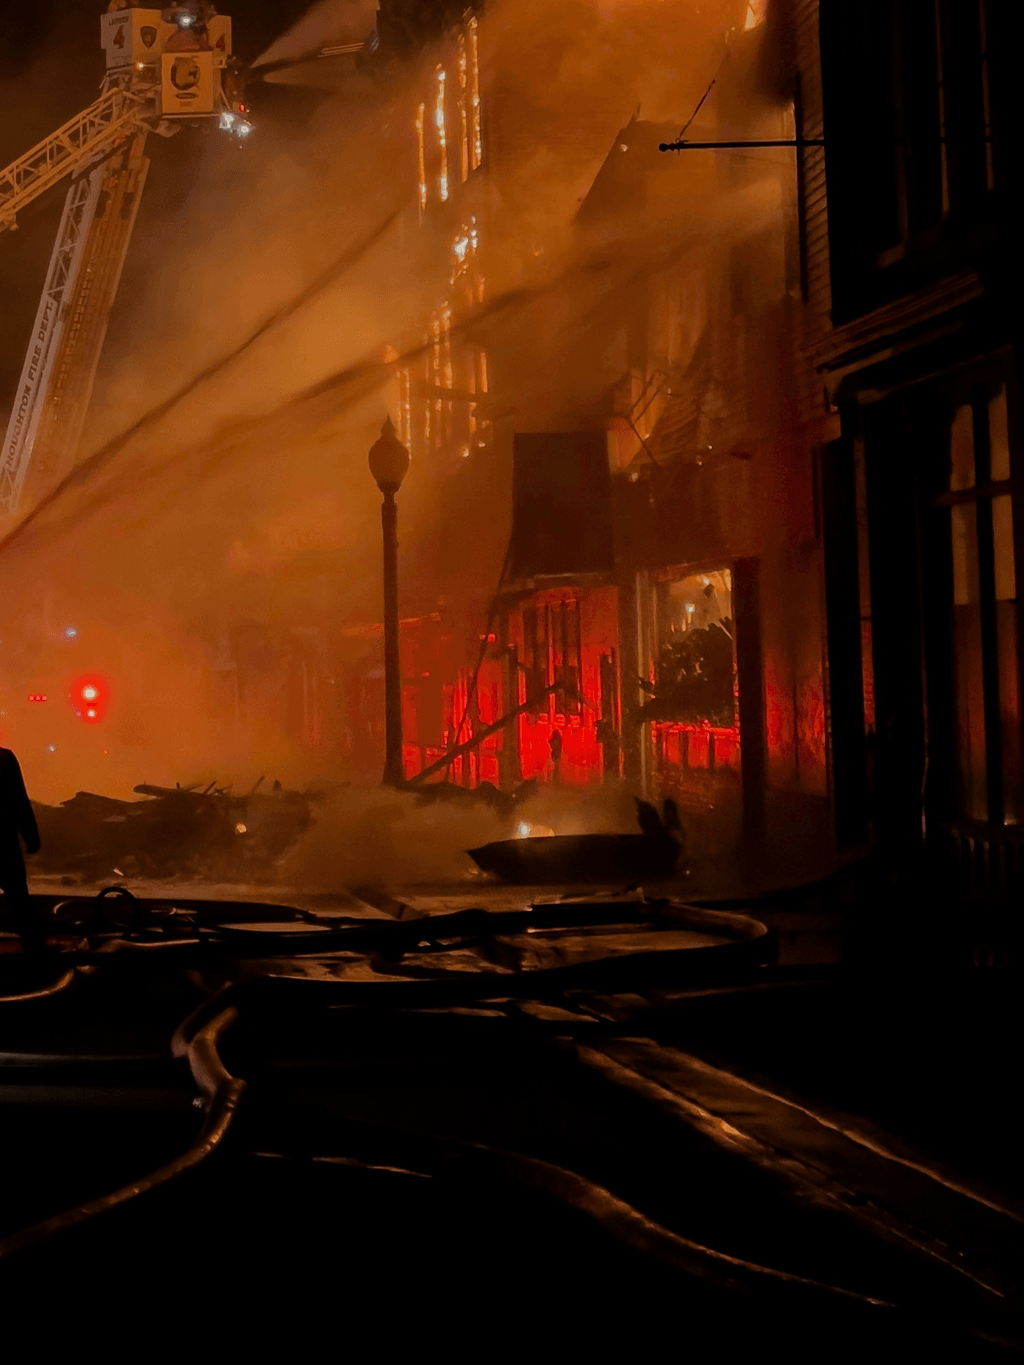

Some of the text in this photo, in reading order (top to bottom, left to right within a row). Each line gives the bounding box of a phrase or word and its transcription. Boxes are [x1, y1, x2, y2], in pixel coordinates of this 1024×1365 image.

[113, 25, 125, 50] 4
[6, 384, 31, 467] HOUGHTON
[28, 344, 42, 381] FIRE
